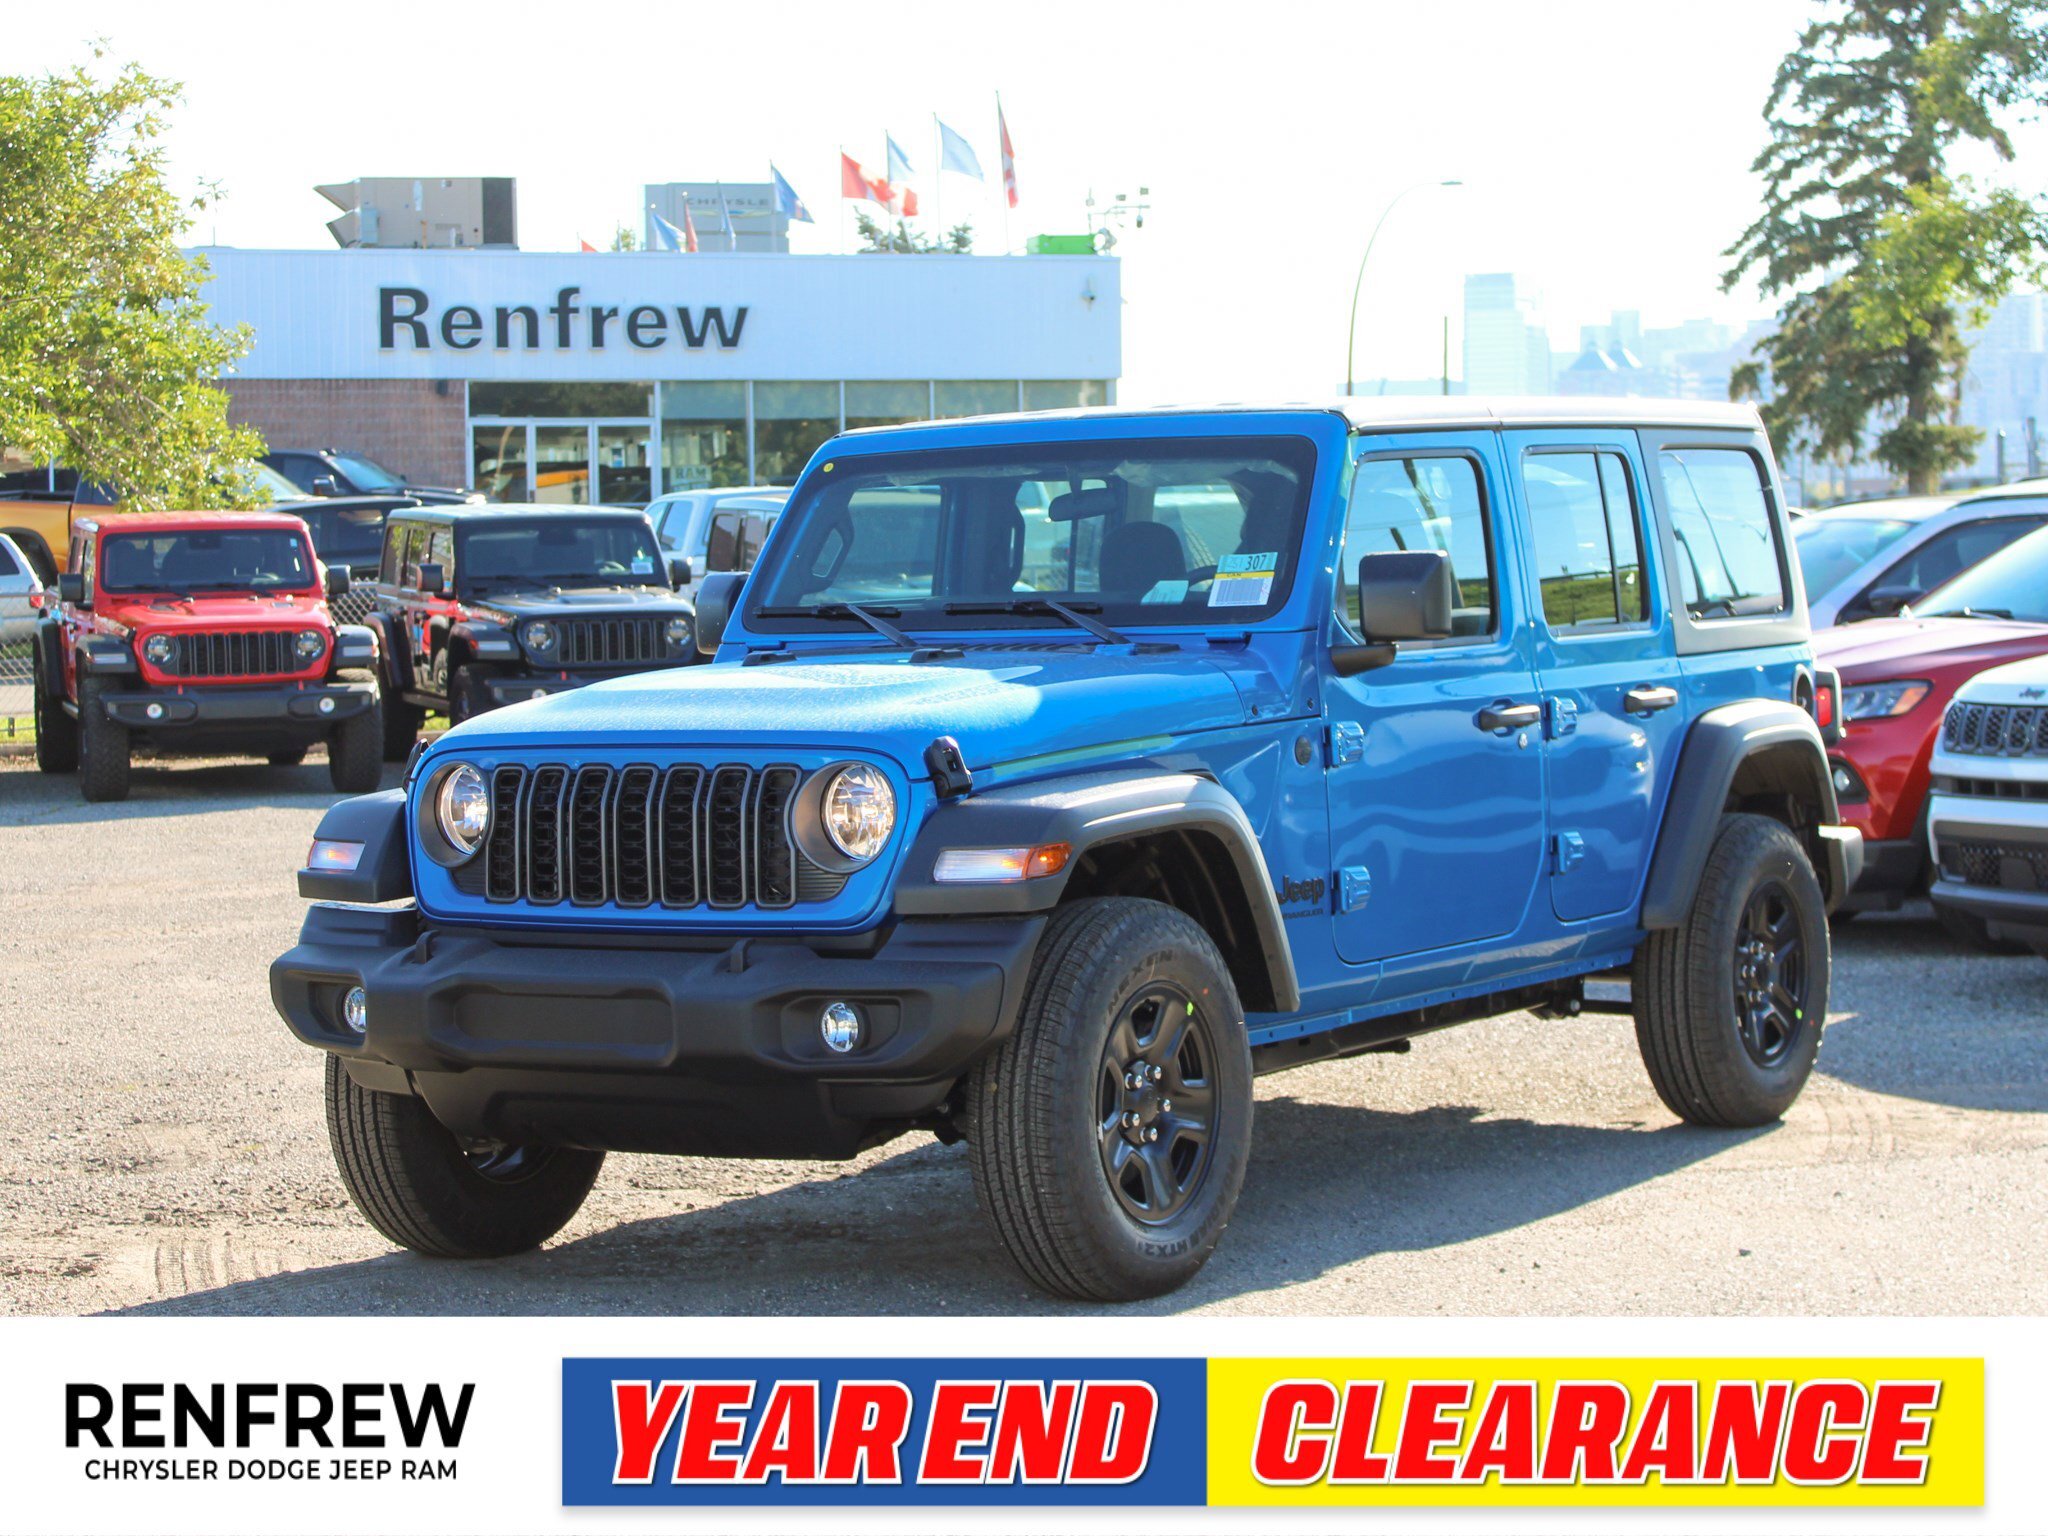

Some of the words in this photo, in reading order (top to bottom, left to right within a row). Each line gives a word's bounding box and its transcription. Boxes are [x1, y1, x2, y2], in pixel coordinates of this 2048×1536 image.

[686, 197, 770, 206] CHRYSLE
[379, 286, 749, 349] Renfrew
[1245, 555, 1267, 570] 307
[1277, 875, 1324, 904] Jeep
[1108, 949, 1174, 1016] NEXEN
